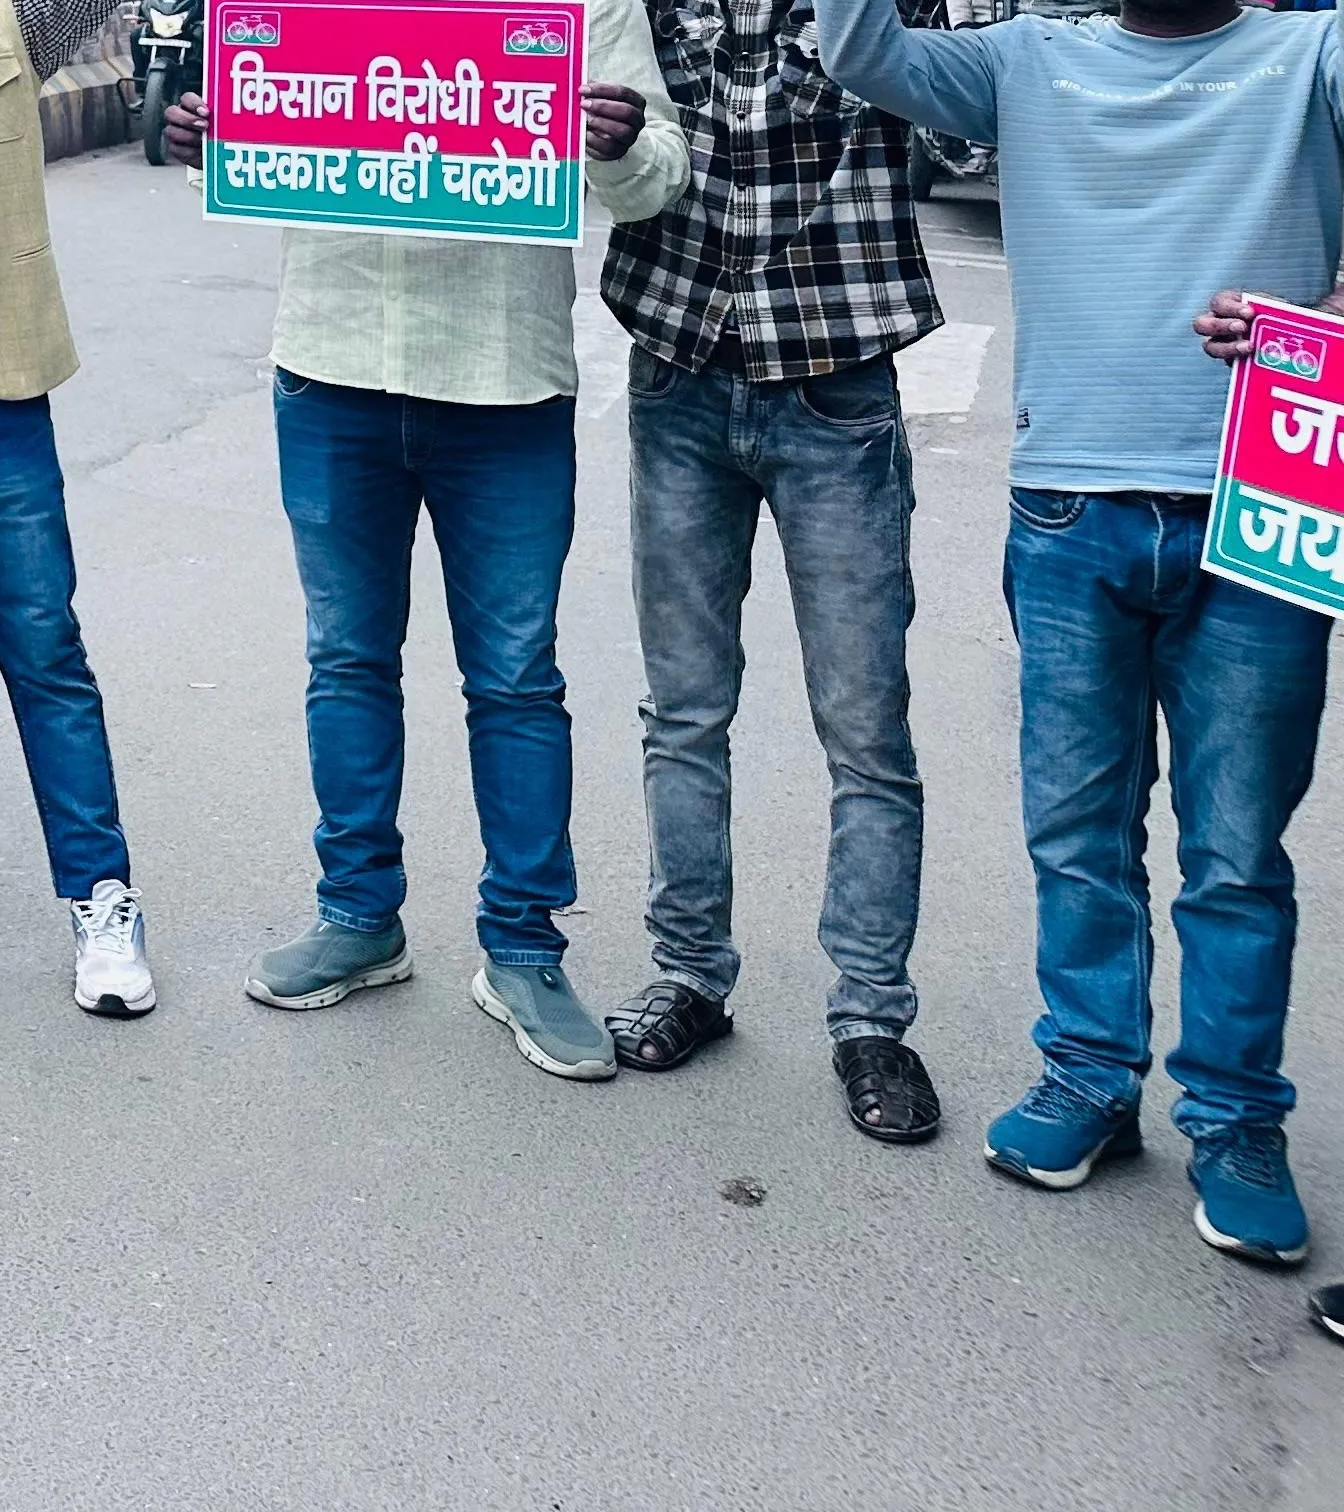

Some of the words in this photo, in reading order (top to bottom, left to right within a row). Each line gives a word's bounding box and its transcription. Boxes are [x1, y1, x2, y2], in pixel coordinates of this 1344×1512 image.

[230, 50, 358, 120] किसान
[365, 55, 484, 126] विरोधी
[492, 81, 557, 135] यह
[224, 142, 351, 196] सरकार
[356, 132, 442, 204] नहीं
[439, 137, 561, 207] चलेगी
